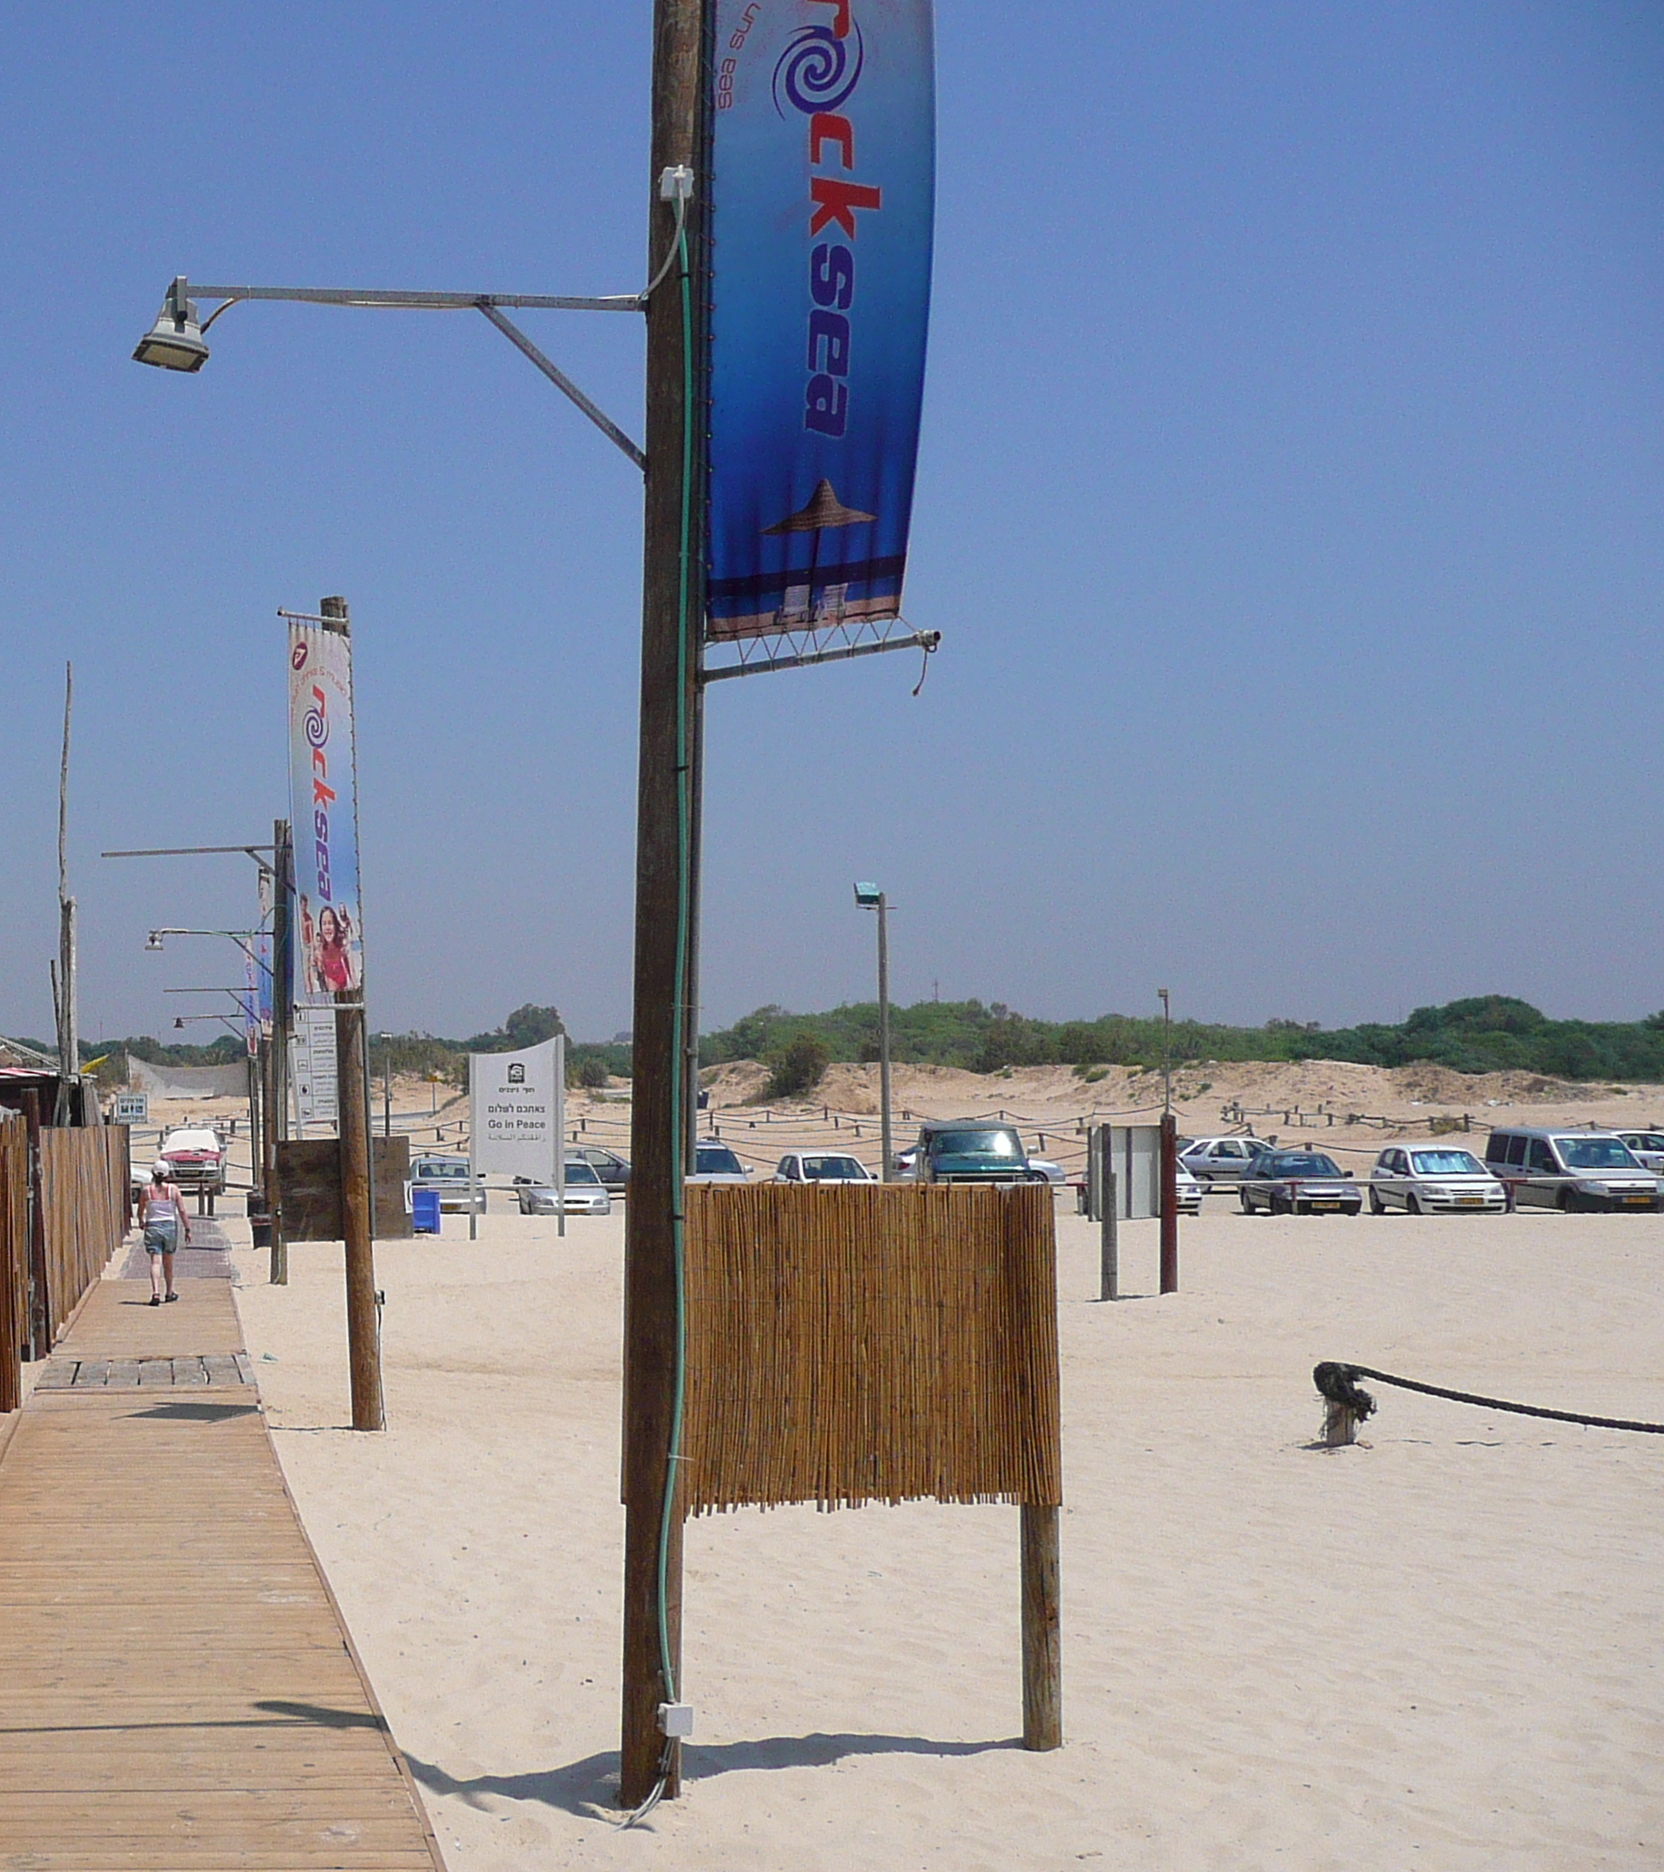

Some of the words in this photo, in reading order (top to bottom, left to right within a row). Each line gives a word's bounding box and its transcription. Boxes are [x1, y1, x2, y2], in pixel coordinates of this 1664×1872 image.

[718, 57, 737, 109] sea
[729, 2, 762, 50] sun
[488, 1119, 502, 1129] Go
[516, 1119, 546, 1129] Peace
